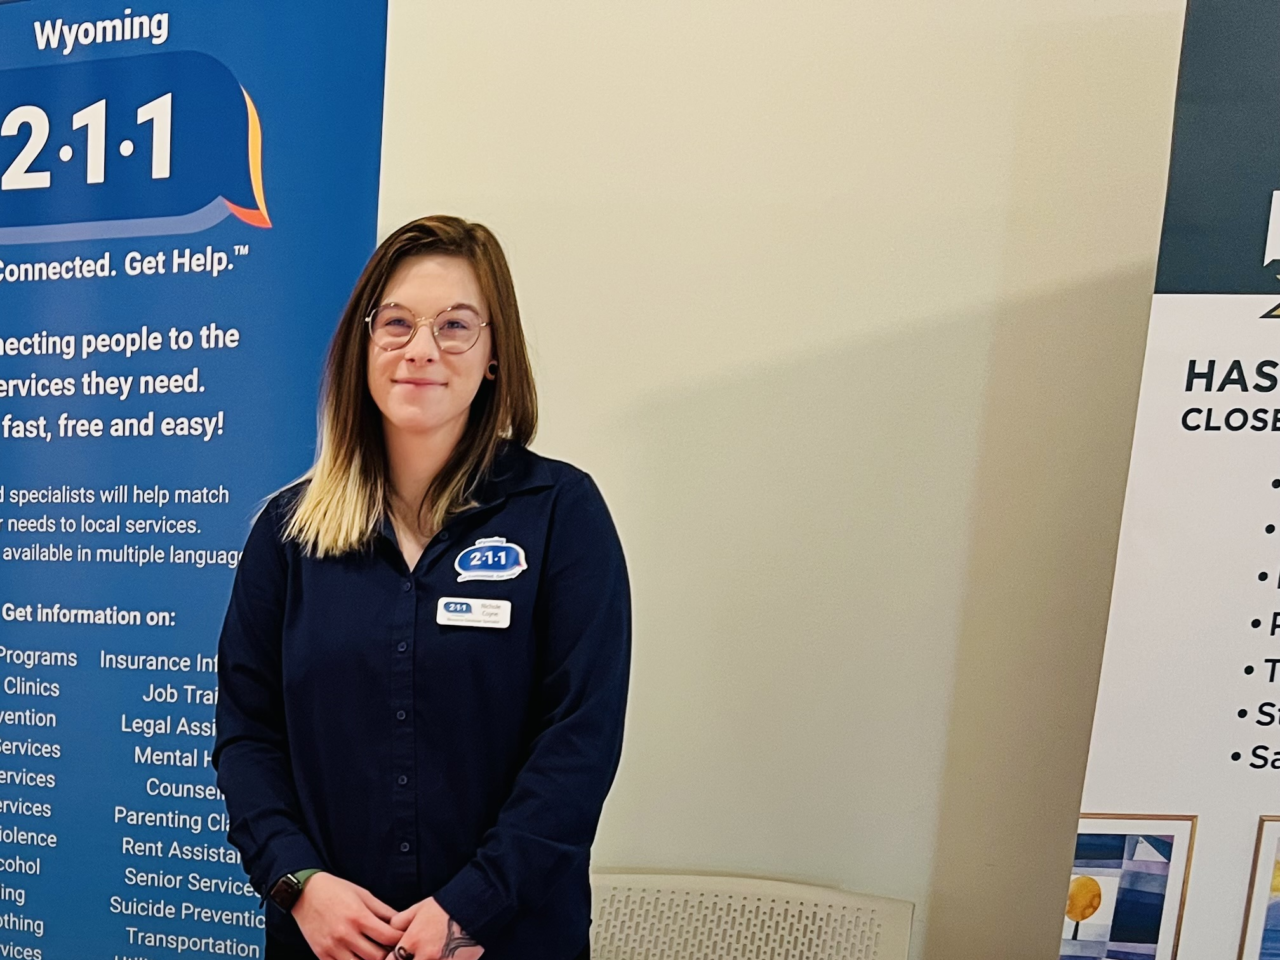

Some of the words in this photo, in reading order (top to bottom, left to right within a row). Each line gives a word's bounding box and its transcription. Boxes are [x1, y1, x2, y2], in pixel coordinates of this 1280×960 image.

[34, 8, 169, 55] Wyoming
[124, 249, 166, 277] Get
[82, 326, 162, 358] people
[169, 326, 193, 349] to
[199, 323, 239, 349] the
[81, 370, 132, 400] they
[139, 367, 204, 394] need.
[1185, 359, 1279, 392] HAS
[2, 414, 51, 442] fast,
[58, 414, 103, 437] free
[110, 412, 153, 437] and
[160, 411, 224, 442] easy!
[9, 486, 94, 506] specialists
[100, 486, 128, 503] will
[133, 486, 169, 507] help
[175, 487, 229, 503] match
[8, 515, 55, 532] needs
[60, 517, 76, 532] to
[81, 516, 120, 533] local
[125, 517, 201, 534] services.
[3, 544, 72, 562] available
[78, 546, 91, 562] in
[96, 545, 165, 566] multiple
[170, 546, 243, 568] languag
[2, 603, 32, 622] Get
[37, 604, 140, 625] information
[146, 608, 175, 626] on:
[100, 650, 191, 671] Insurance
[4, 676, 59, 697] Clinics
[143, 684, 177, 703] Job
[121, 714, 170, 736] Legal
[134, 746, 197, 767] Mental
[115, 806, 202, 833] Parenting
[122, 837, 162, 857] Rent
[168, 841, 241, 864] Assista
[124, 868, 182, 889] Senior
[110, 897, 176, 919] Suicide
[181, 903, 266, 929] Preventio
[126, 928, 259, 958] Transportation
